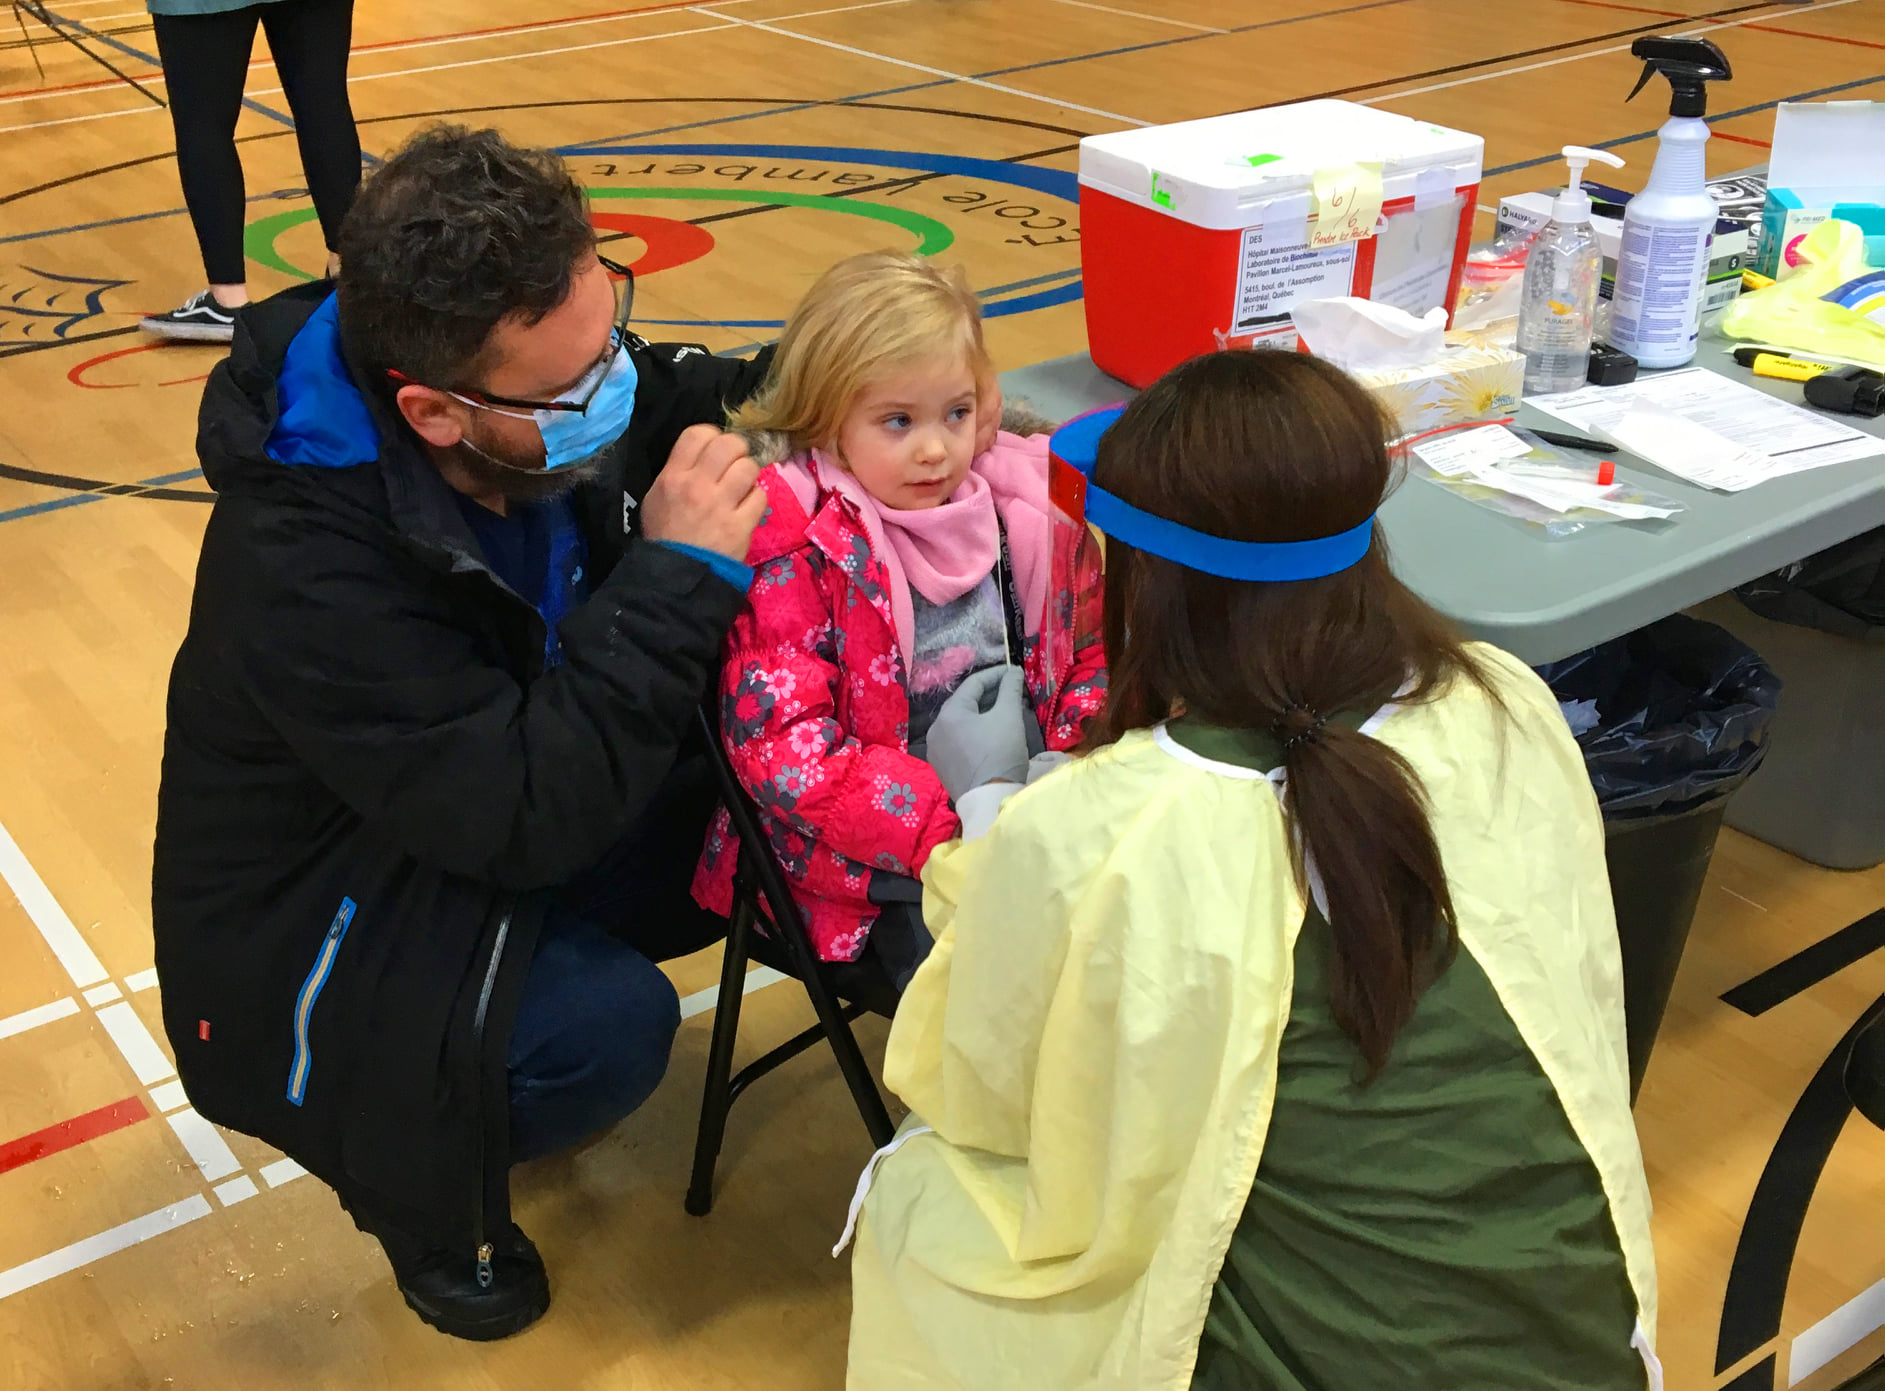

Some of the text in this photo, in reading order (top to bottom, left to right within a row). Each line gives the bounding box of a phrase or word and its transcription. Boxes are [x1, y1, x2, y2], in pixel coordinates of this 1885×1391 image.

[1249, 235, 1262, 244] DES
[1248, 249, 1269, 259] Hôpital
[1247, 257, 1280, 268] Laboratoire
[1281, 255, 1289, 263] de
[1731, 258, 1737, 268] S
[1246, 269, 1269, 279] Pavillon
[1326, 256, 1351, 265] sous-sol
[1244, 284, 1260, 294] 5415,
[1261, 282, 1276, 291] boul.
[1287, 274, 1324, 286] l'Assomption
[1272, 290, 1295, 299] Québec
[1242, 303, 1268, 313] H1T 2M4
